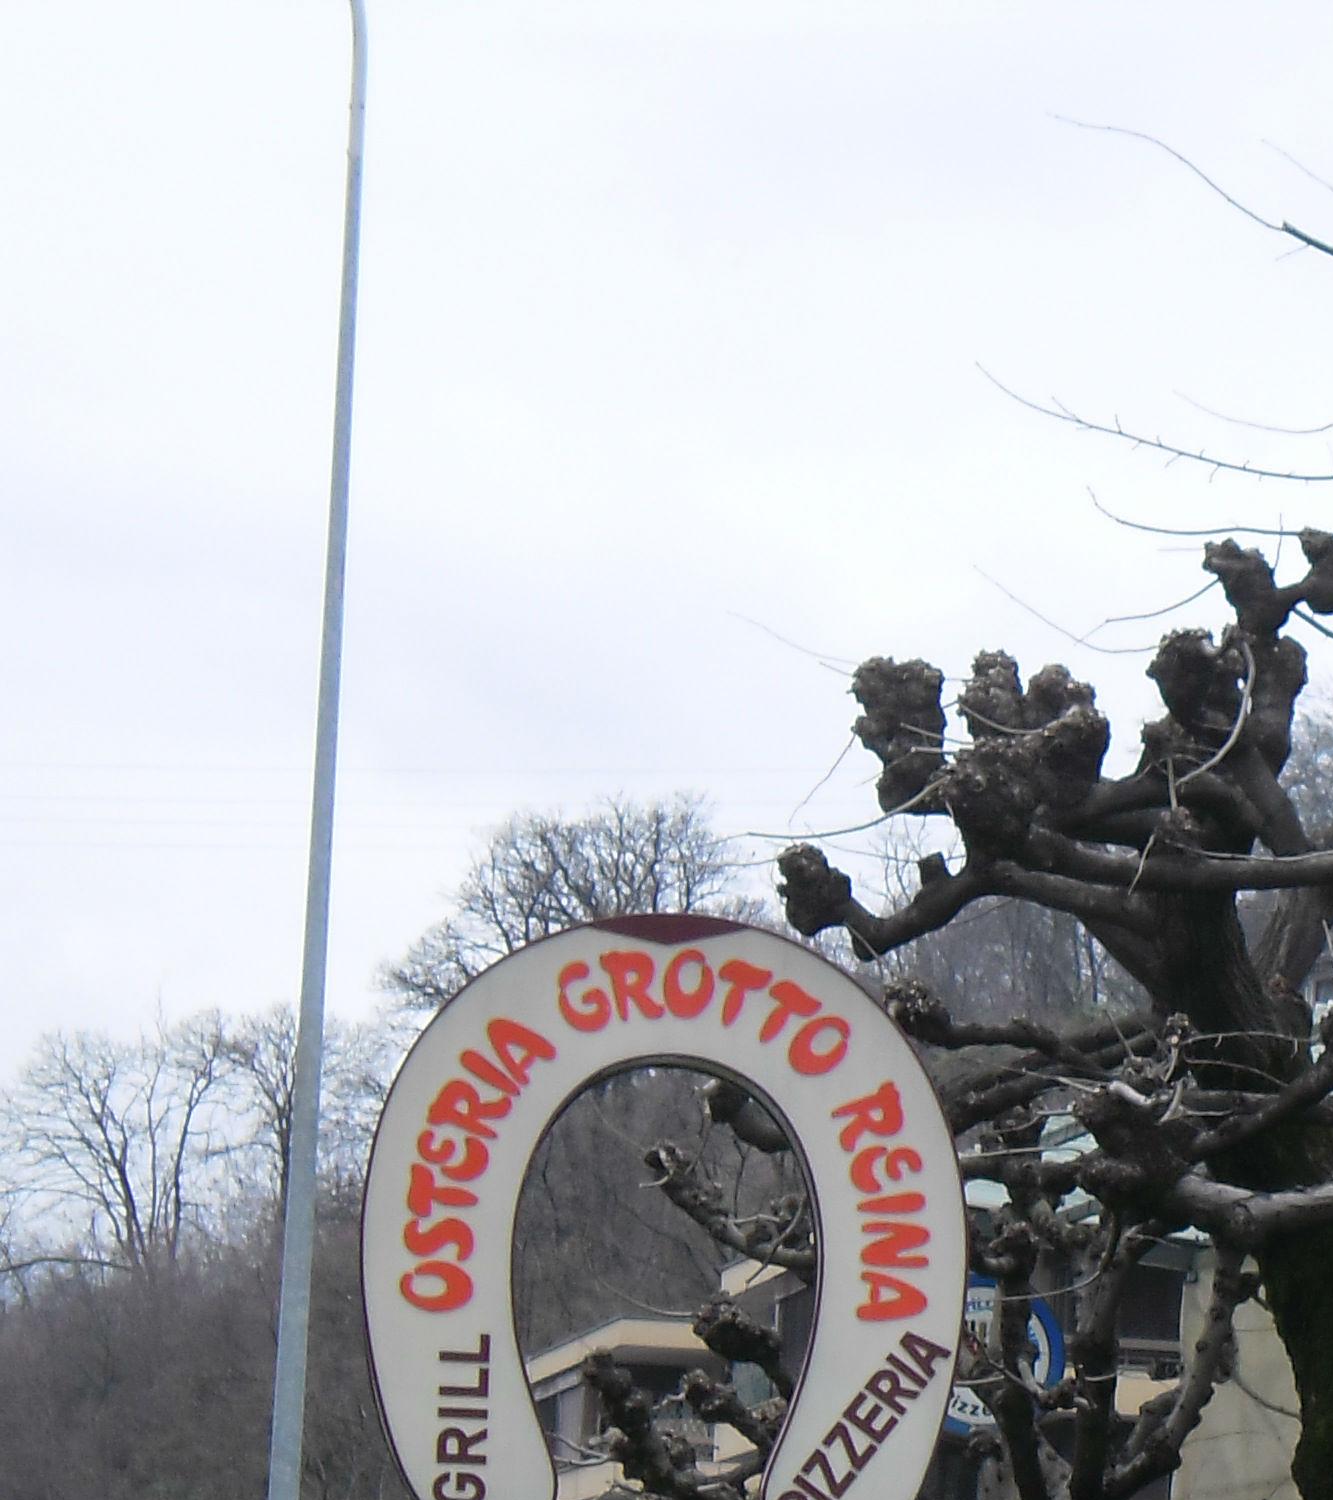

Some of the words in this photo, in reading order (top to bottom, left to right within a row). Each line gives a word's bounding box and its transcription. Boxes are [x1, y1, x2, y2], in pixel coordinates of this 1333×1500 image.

[399, 1017, 558, 1313] OSTERIA
[558, 948, 852, 1076] GROTTO
[831, 1080, 931, 1322] REINA
